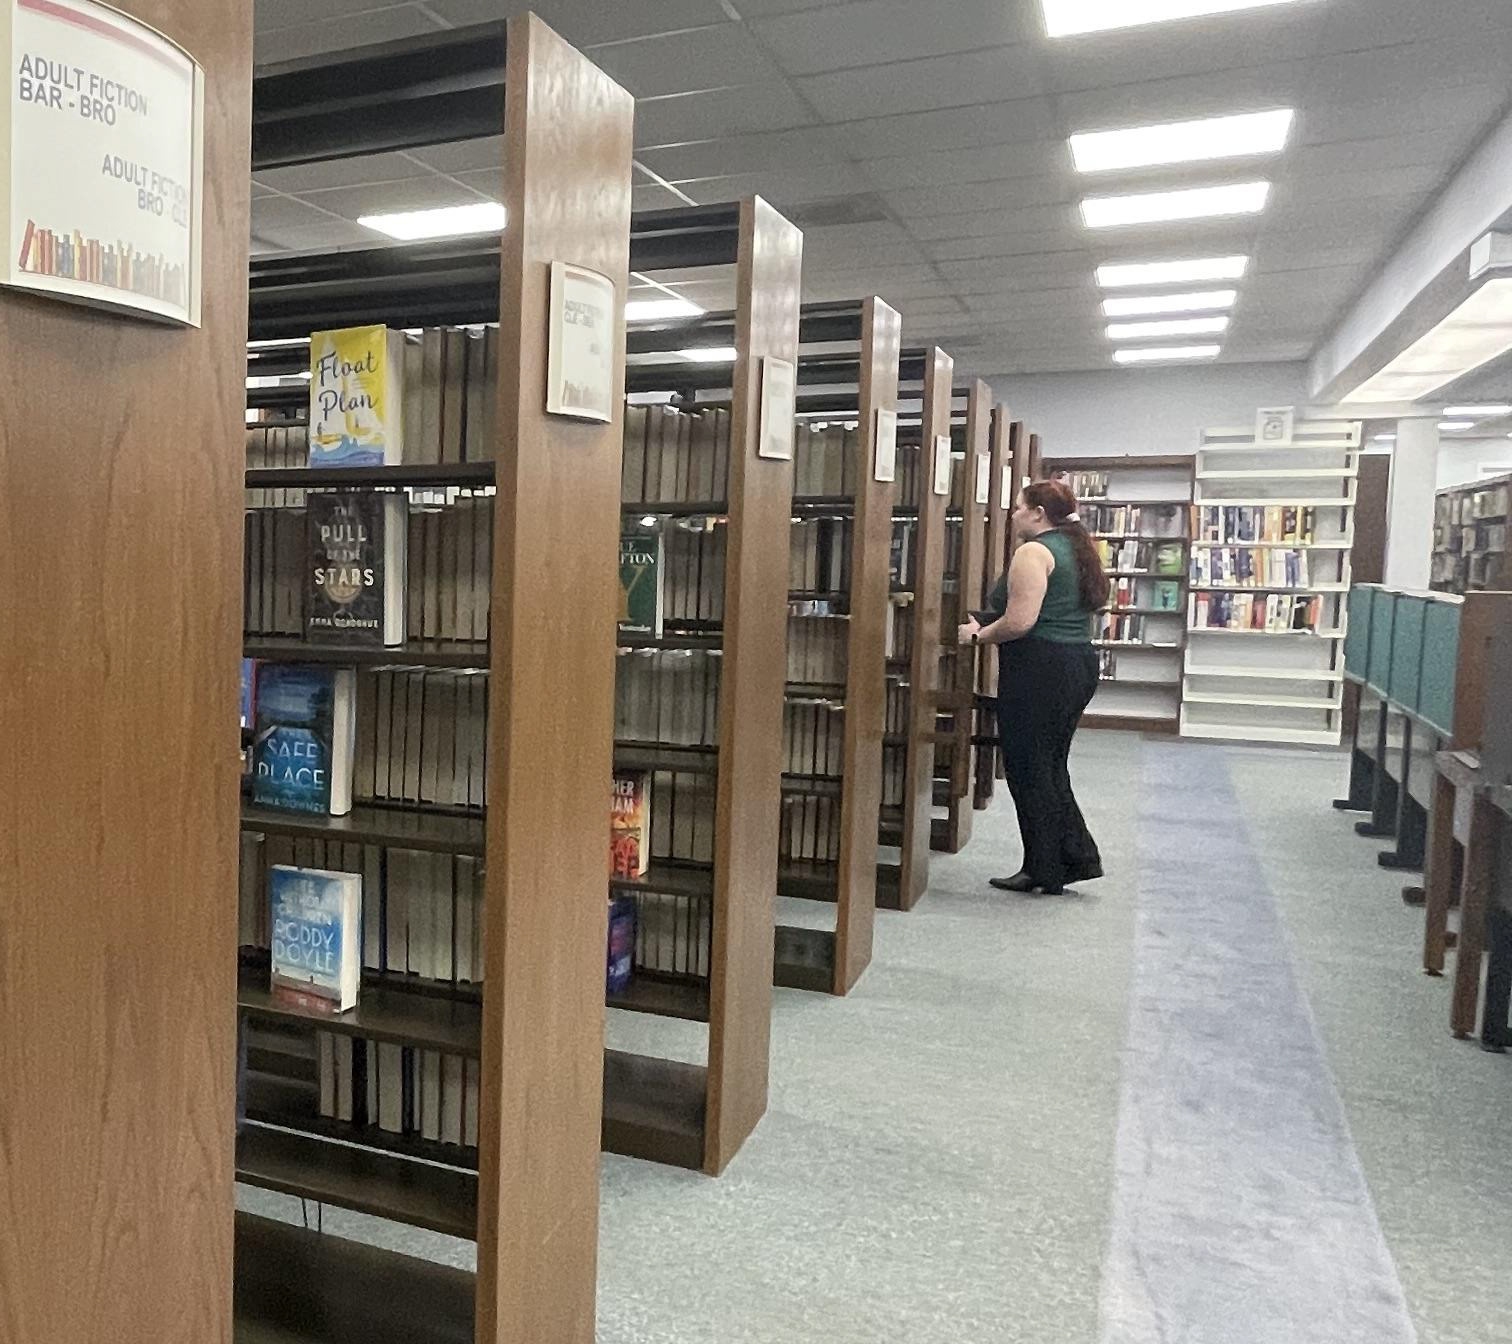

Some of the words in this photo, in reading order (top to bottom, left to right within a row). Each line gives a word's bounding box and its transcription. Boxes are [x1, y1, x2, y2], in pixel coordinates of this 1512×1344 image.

[19, 53, 84, 92] ADULT
[89, 73, 148, 116] FICTION
[19, 77, 63, 110] BAR
[80, 94, 116, 126] BRO
[102, 153, 148, 187] ADULT
[137, 188, 163, 217] BRO
[316, 351, 379, 387] Float
[319, 391, 378, 420] Plan
[321, 525, 367, 542] PULL
[314, 568, 374, 586] STARS
[267, 738, 318, 758] SAFE
[258, 761, 325, 790] PLACE
[274, 919, 334, 950] RODDY
[274, 939, 335, 972] DOYLE
